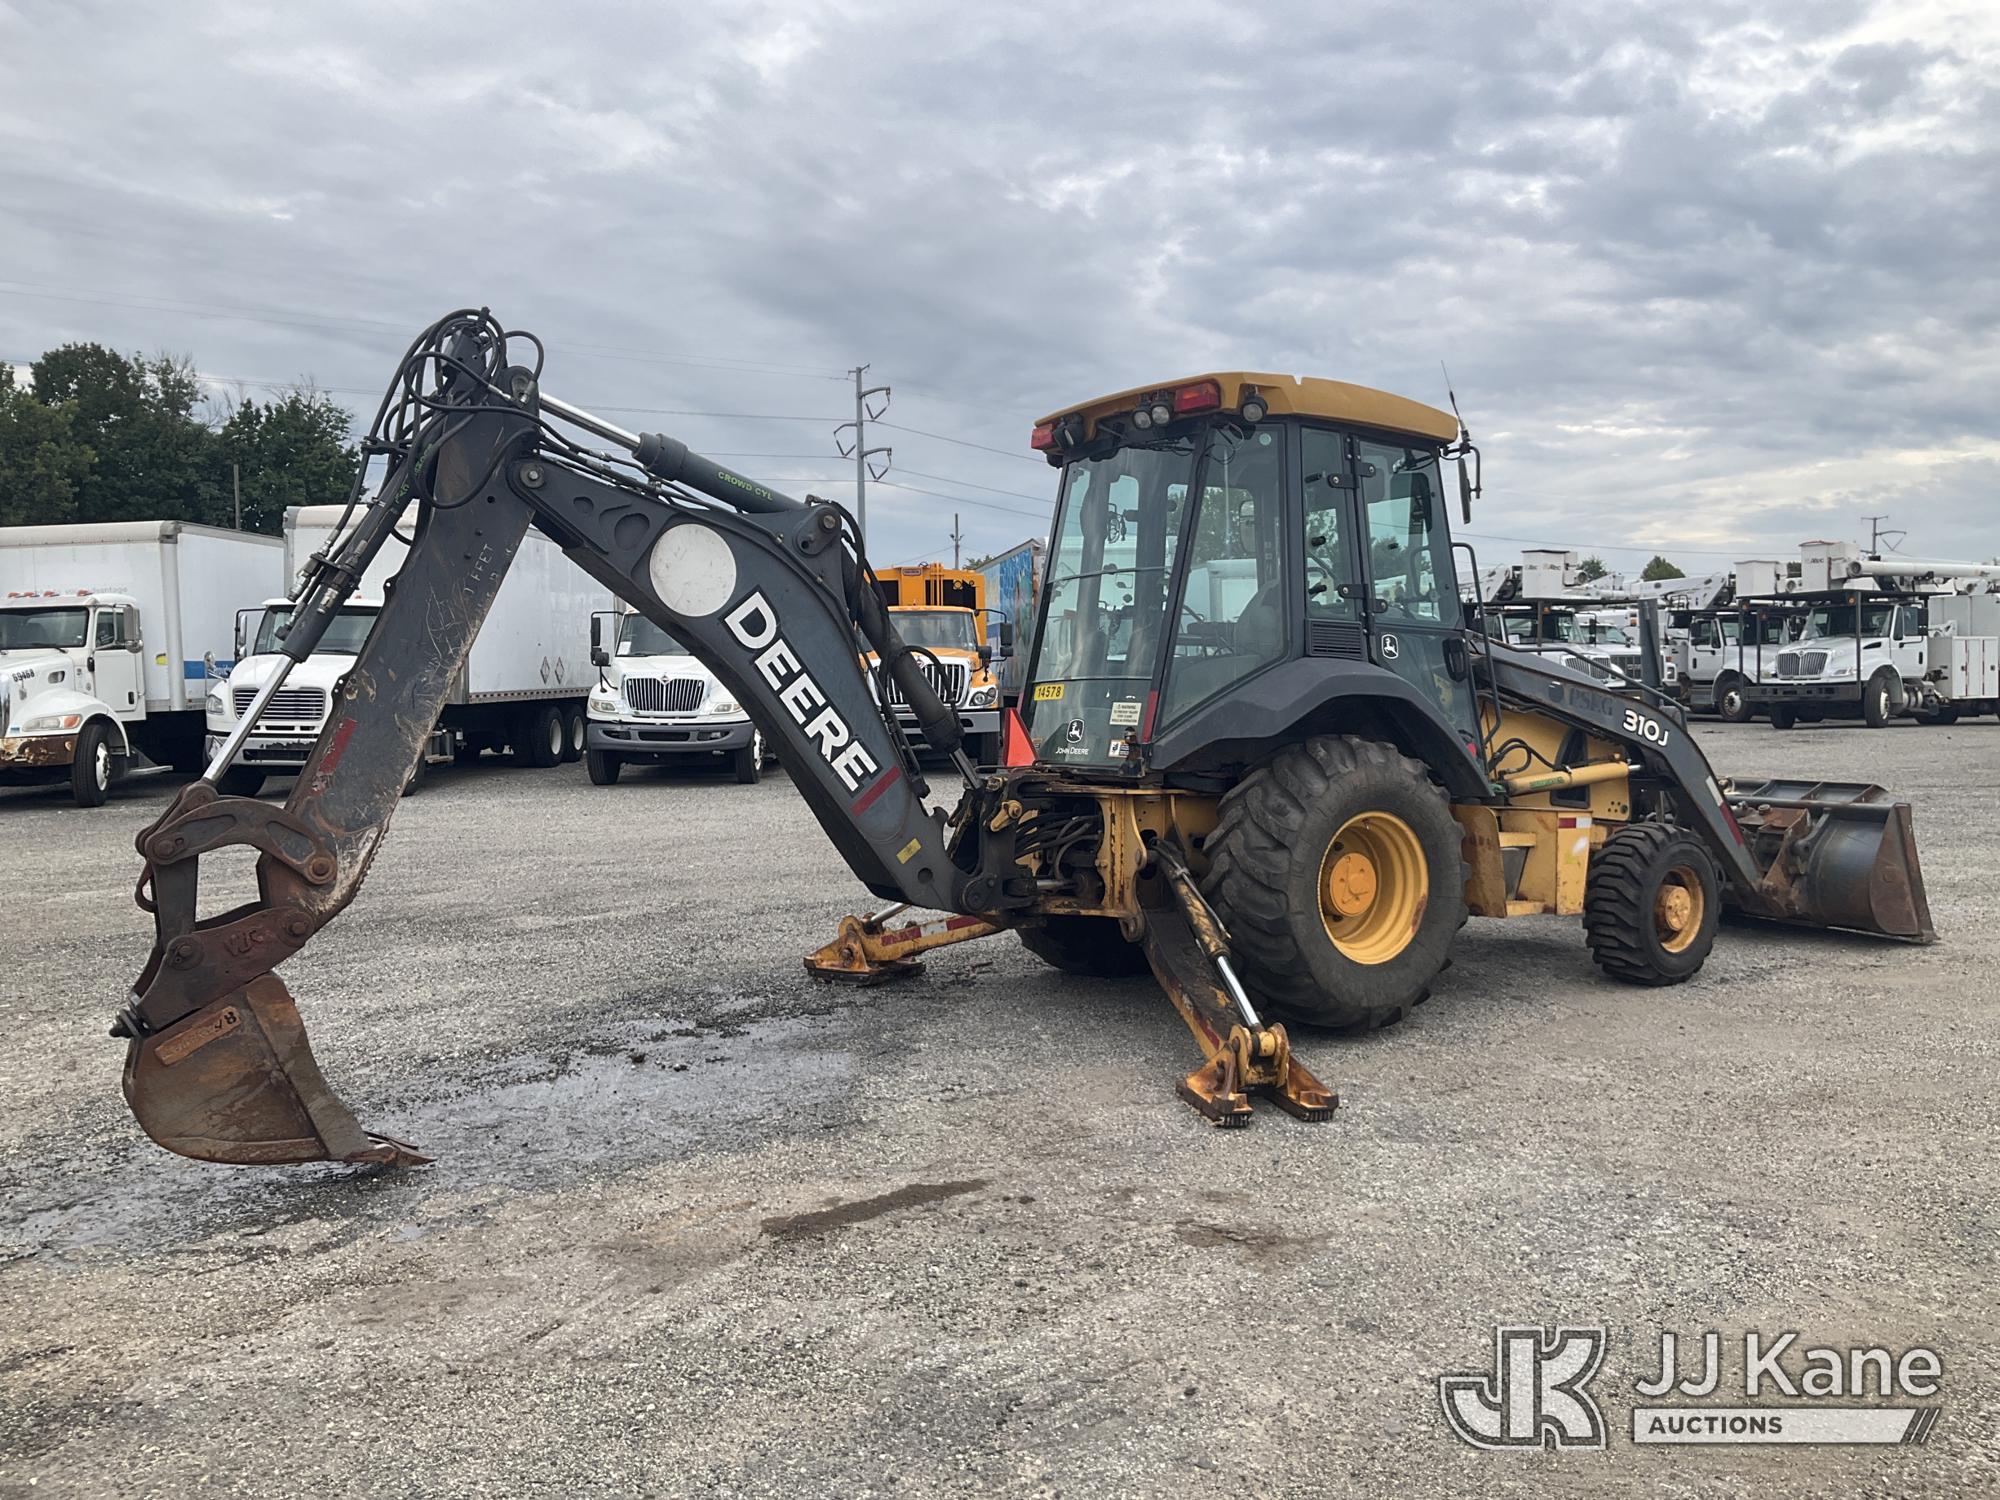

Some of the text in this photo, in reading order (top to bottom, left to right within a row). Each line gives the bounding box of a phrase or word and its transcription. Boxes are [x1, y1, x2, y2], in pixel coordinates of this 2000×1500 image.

[717, 471, 774, 501] CROWD CYL
[724, 591, 878, 792] DEERE
[1037, 686, 1062, 698] 14578
[1623, 709, 1669, 746] 310J
[1055, 746, 1089, 755] JOHN DEERE
